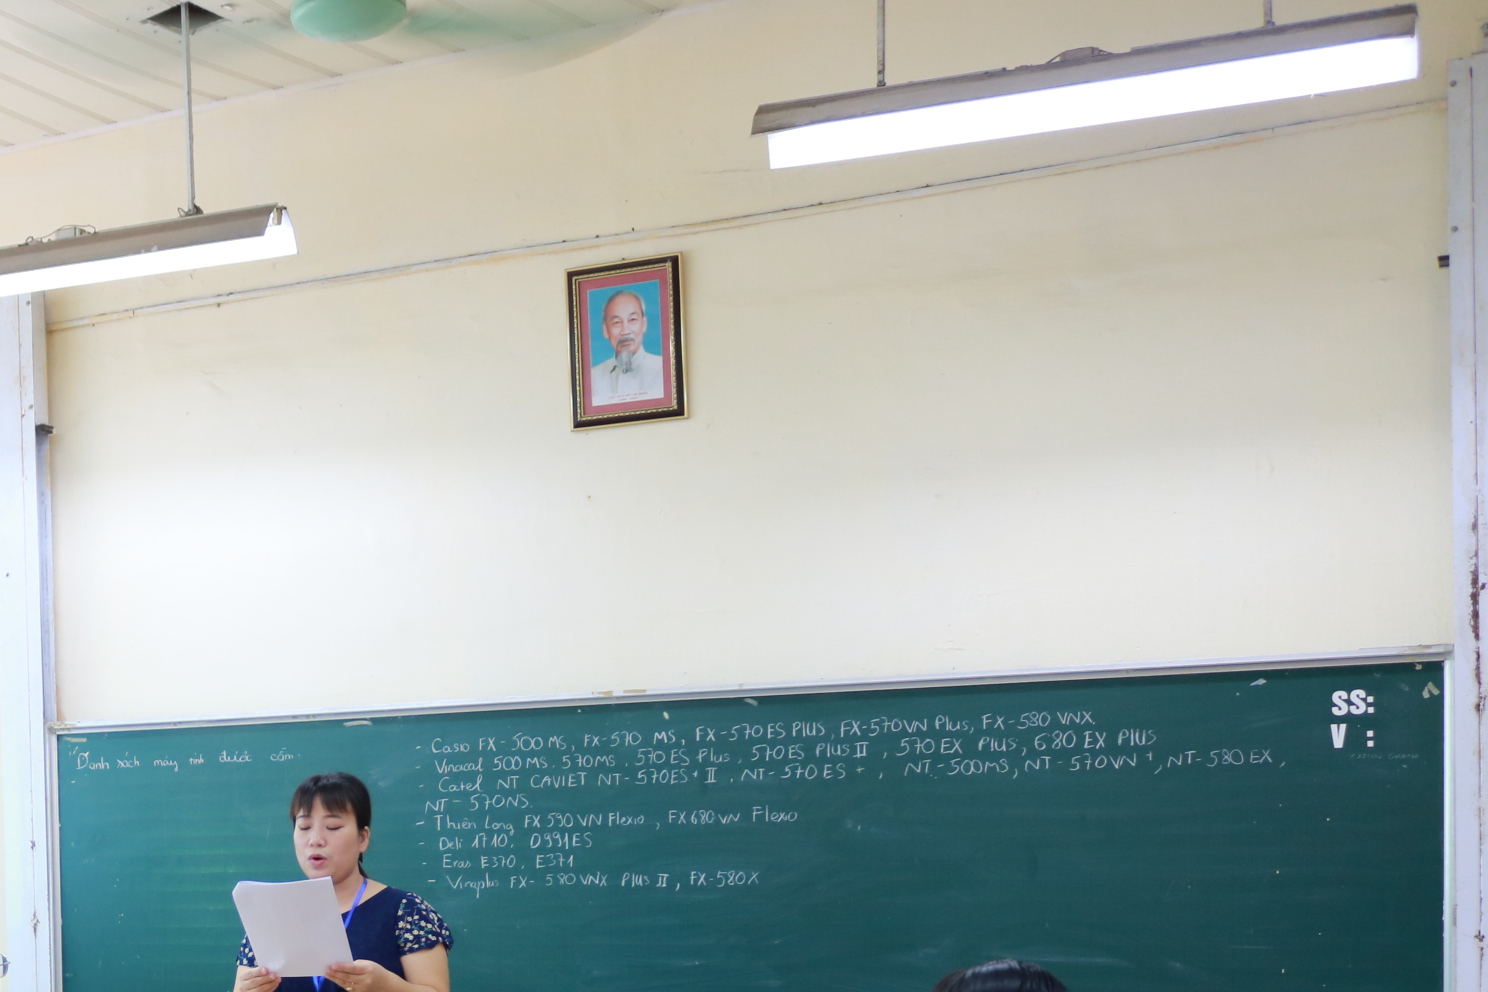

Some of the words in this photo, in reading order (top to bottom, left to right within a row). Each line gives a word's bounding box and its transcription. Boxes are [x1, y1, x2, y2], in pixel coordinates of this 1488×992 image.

[1332, 690, 1374, 715] SS:
[431, 738, 470, 753] Casio
[1330, 723, 1347, 749] V
[530, 768, 587, 788] CAVIET
[439, 837, 463, 851] Deli
